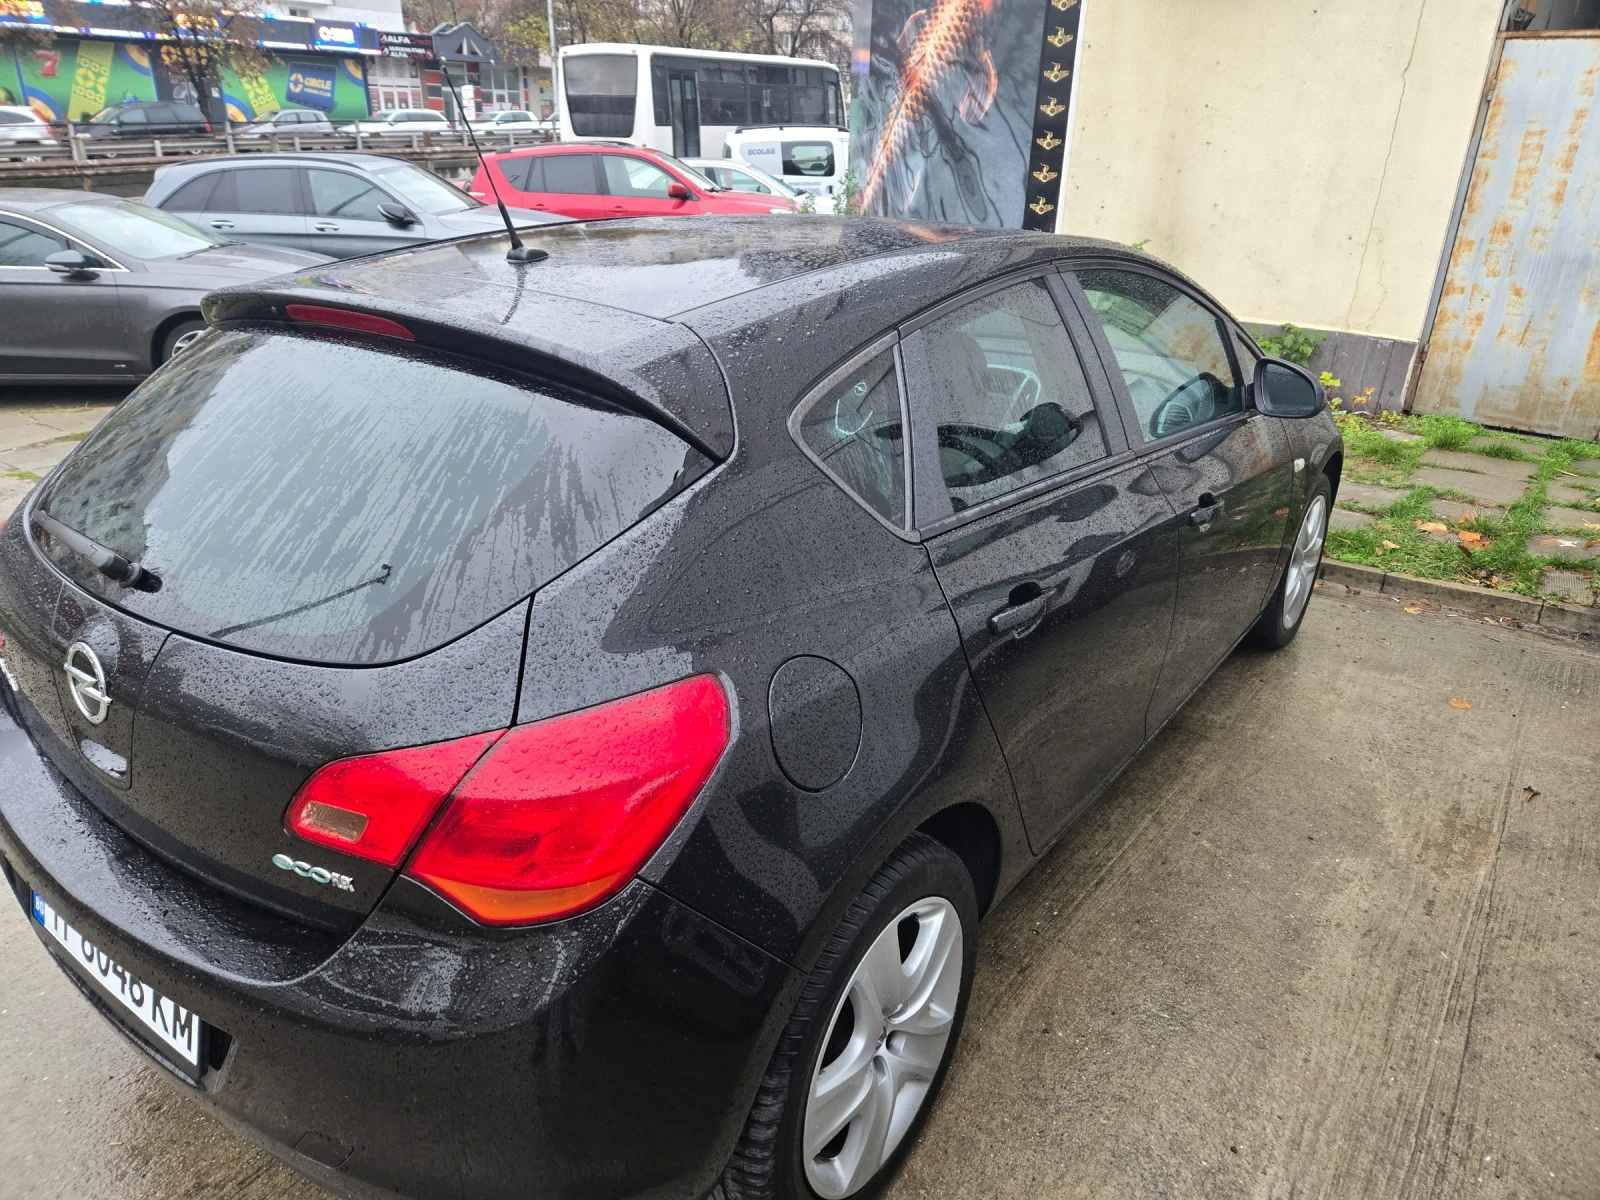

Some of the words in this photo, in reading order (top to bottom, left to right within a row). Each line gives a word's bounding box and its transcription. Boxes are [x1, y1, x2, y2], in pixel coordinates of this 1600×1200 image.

[387, 34, 411, 45] ALFA
[304, 77, 333, 91] CIRCLE
[35, 895, 45, 916] BG
[151, 989, 193, 1053] KM
